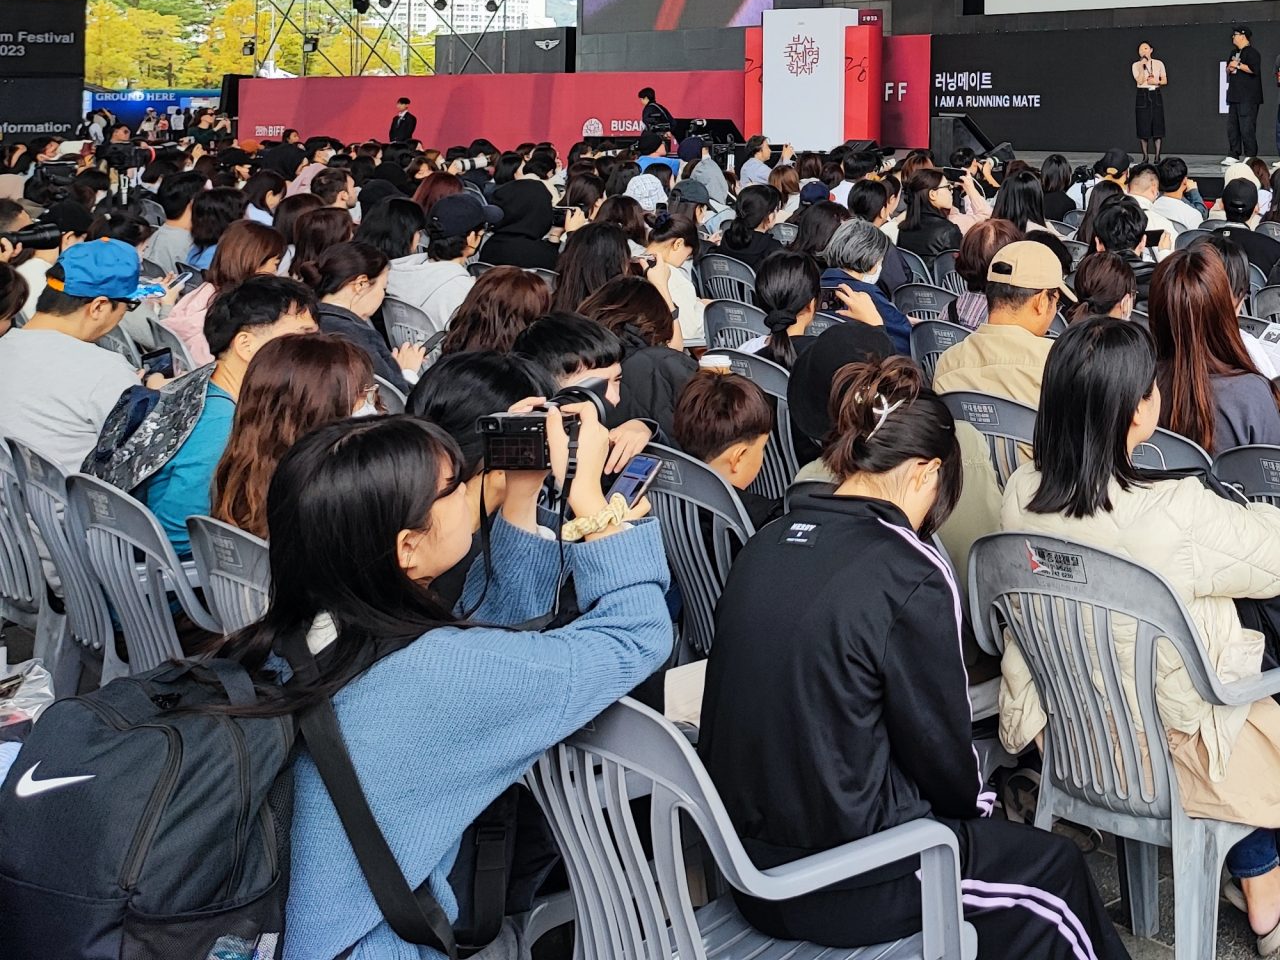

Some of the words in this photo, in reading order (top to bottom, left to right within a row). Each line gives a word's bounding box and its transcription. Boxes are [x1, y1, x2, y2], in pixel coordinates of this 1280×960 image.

[17, 31, 75, 44] Festival
[935, 71, 993, 92] 러닝메이트
[95, 92, 145, 102] GROUND
[146, 92, 177, 102] HERE
[934, 95, 938, 108] I
[939, 96, 956, 108] AM
[956, 96, 965, 108] A
[965, 95, 1010, 108] RUNNING
[1012, 95, 1041, 108] MATE
